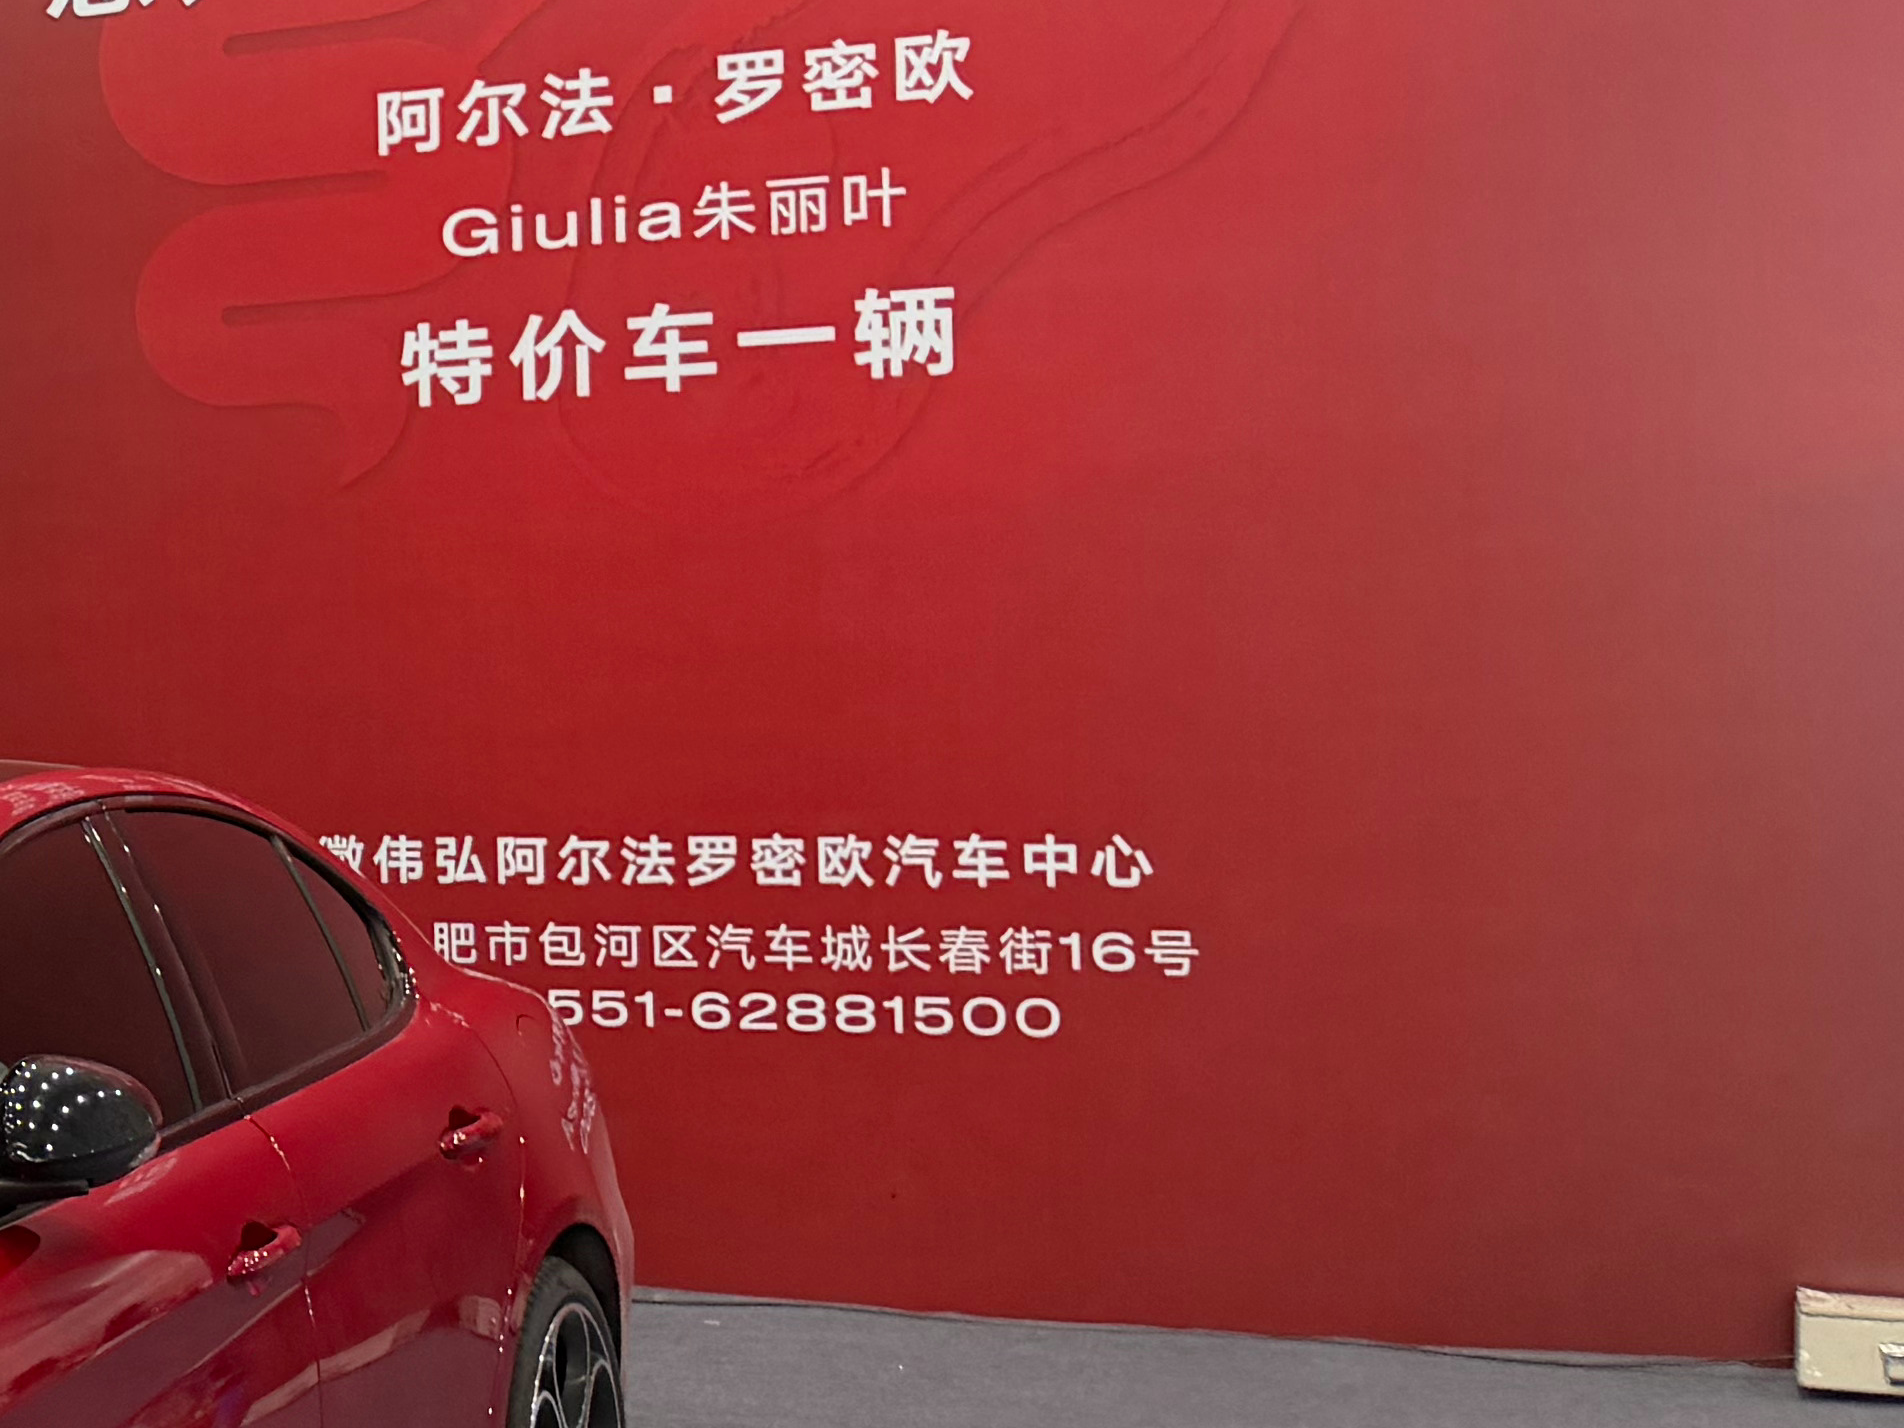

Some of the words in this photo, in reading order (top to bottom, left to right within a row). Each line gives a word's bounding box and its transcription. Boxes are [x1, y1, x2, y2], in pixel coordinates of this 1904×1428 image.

[441, 166, 907, 258] Giulia朱丽叶
[400, 285, 955, 408] 特价车一辆
